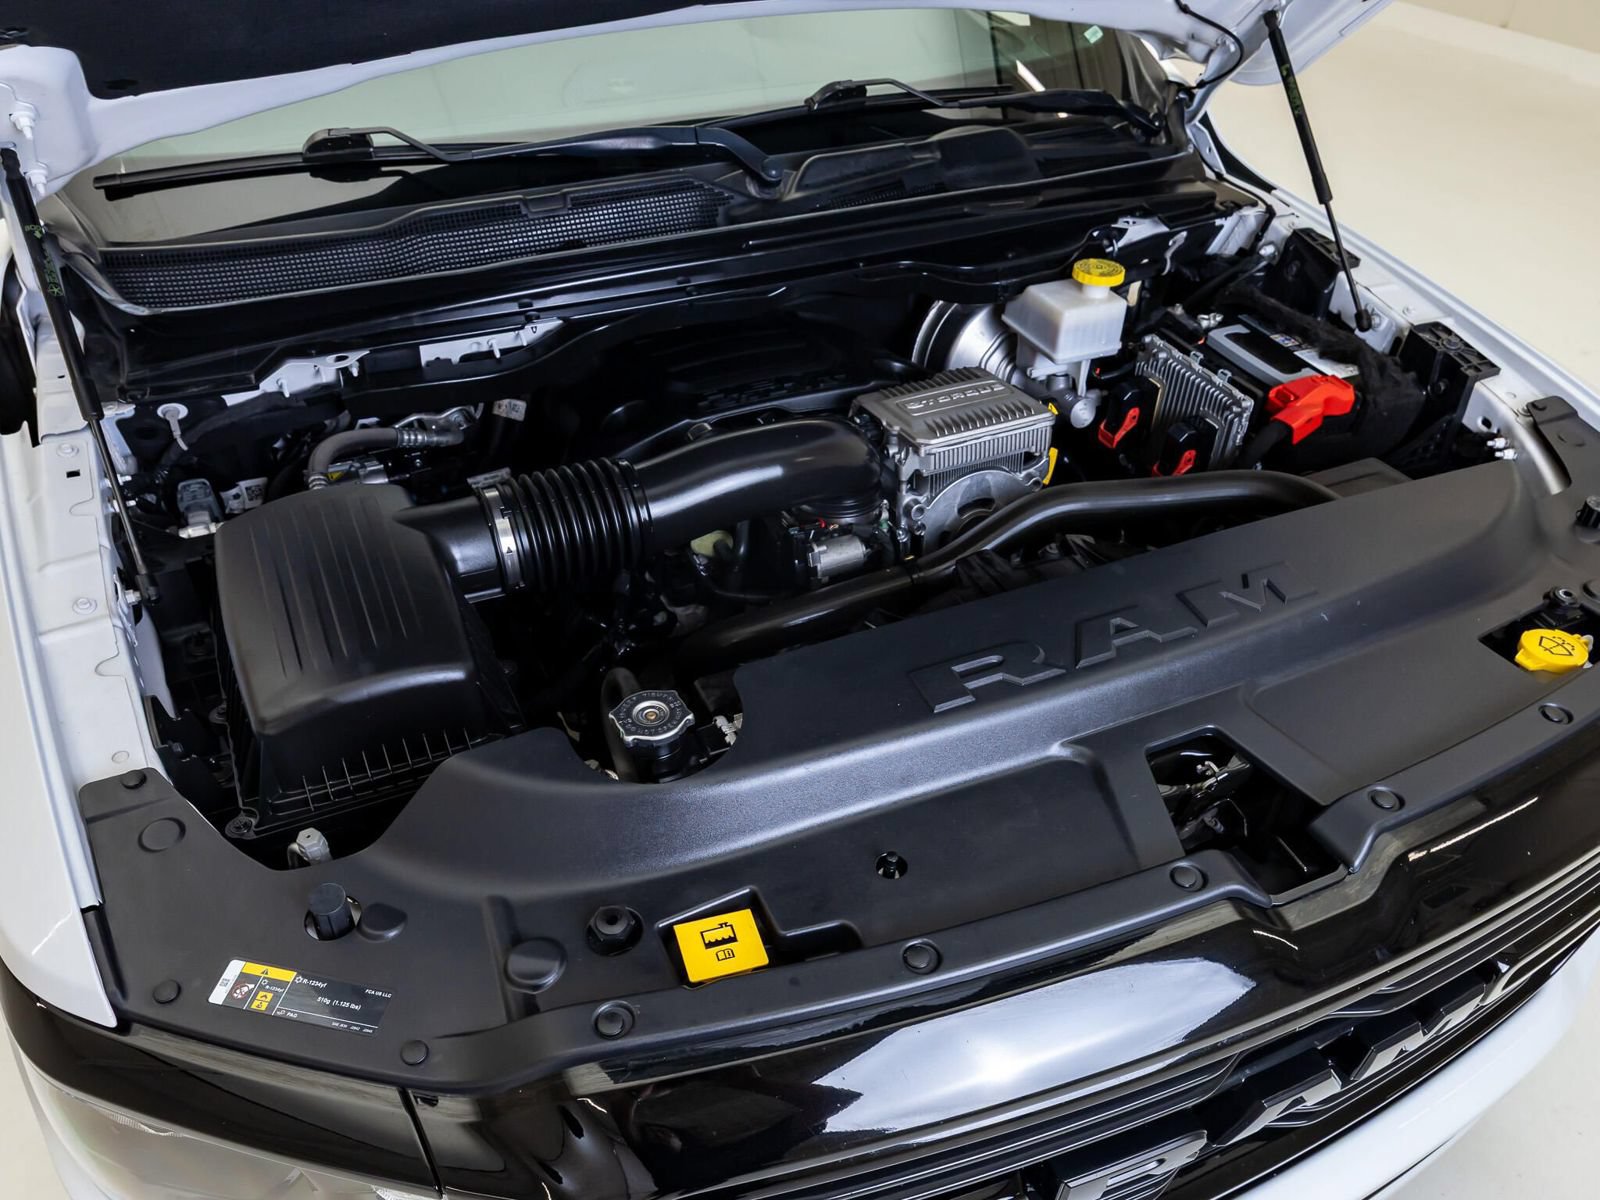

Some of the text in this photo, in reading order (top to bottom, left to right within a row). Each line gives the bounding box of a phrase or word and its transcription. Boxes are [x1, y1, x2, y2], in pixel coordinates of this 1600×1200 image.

[908, 560, 1319, 713] RAM
[302, 978, 328, 988] R-1234yf
[332, 999, 350, 1008] (1.125
